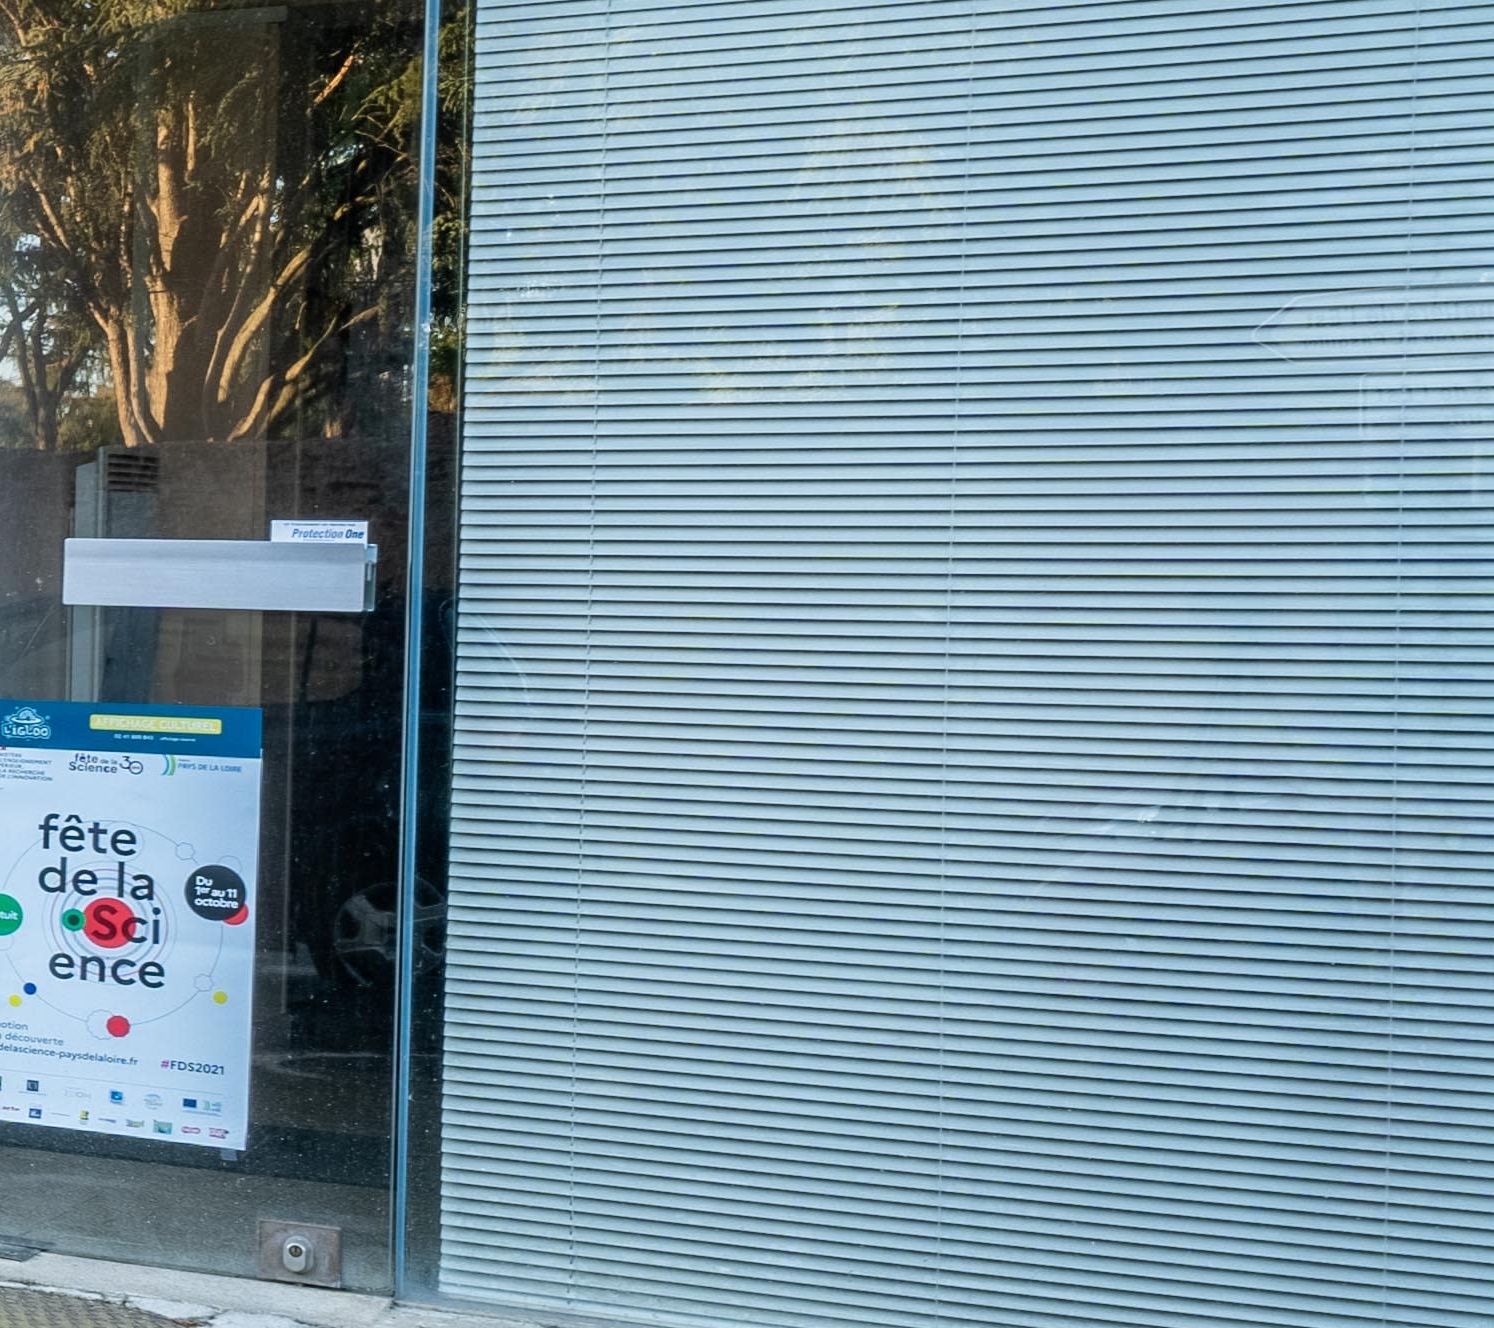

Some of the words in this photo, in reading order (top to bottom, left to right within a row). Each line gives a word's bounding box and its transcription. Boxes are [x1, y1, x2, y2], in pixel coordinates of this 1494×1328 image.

[292, 528, 344, 539] Protection
[345, 529, 365, 539] One
[94, 717, 156, 729] AFFICHAGE
[158, 719, 216, 731] CULTUREL
[2, 724, 51, 739] L'IGLOO
[74, 753, 98, 764] fête
[69, 761, 118, 774] Science
[38, 813, 137, 856] fête
[38, 856, 98, 896] de
[118, 861, 154, 900] la
[196, 875, 213, 887] Du
[211, 888, 225, 898] au
[194, 897, 239, 909] octobre
[92, 904, 161, 945] Sci
[49, 952, 165, 989] ence
[5, 1031, 64, 1046] découverte
[160, 1058, 226, 1076] #FDS2021
